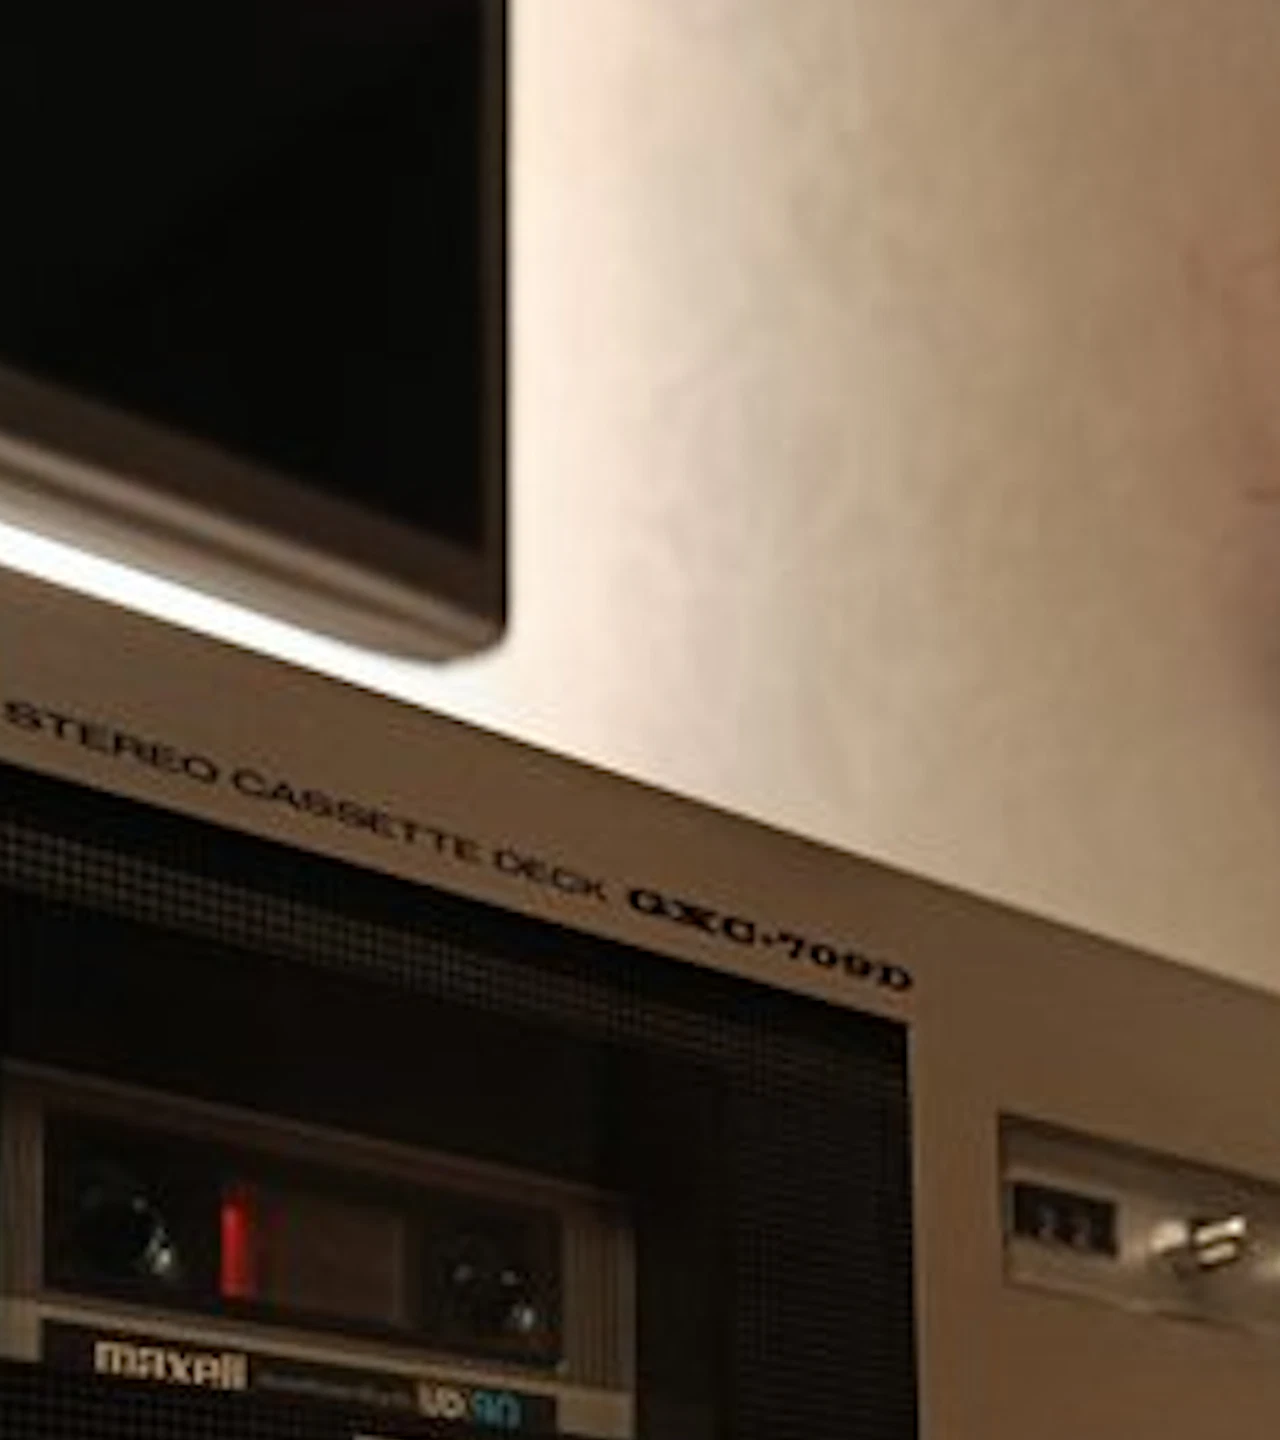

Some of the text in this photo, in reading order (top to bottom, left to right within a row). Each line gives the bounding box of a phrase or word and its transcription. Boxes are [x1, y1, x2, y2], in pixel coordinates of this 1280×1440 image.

[4, 699, 220, 785] STEREO
[231, 768, 482, 864] CASSETTE
[492, 844, 609, 902] DECK
[93, 1340, 248, 1392] maxell
